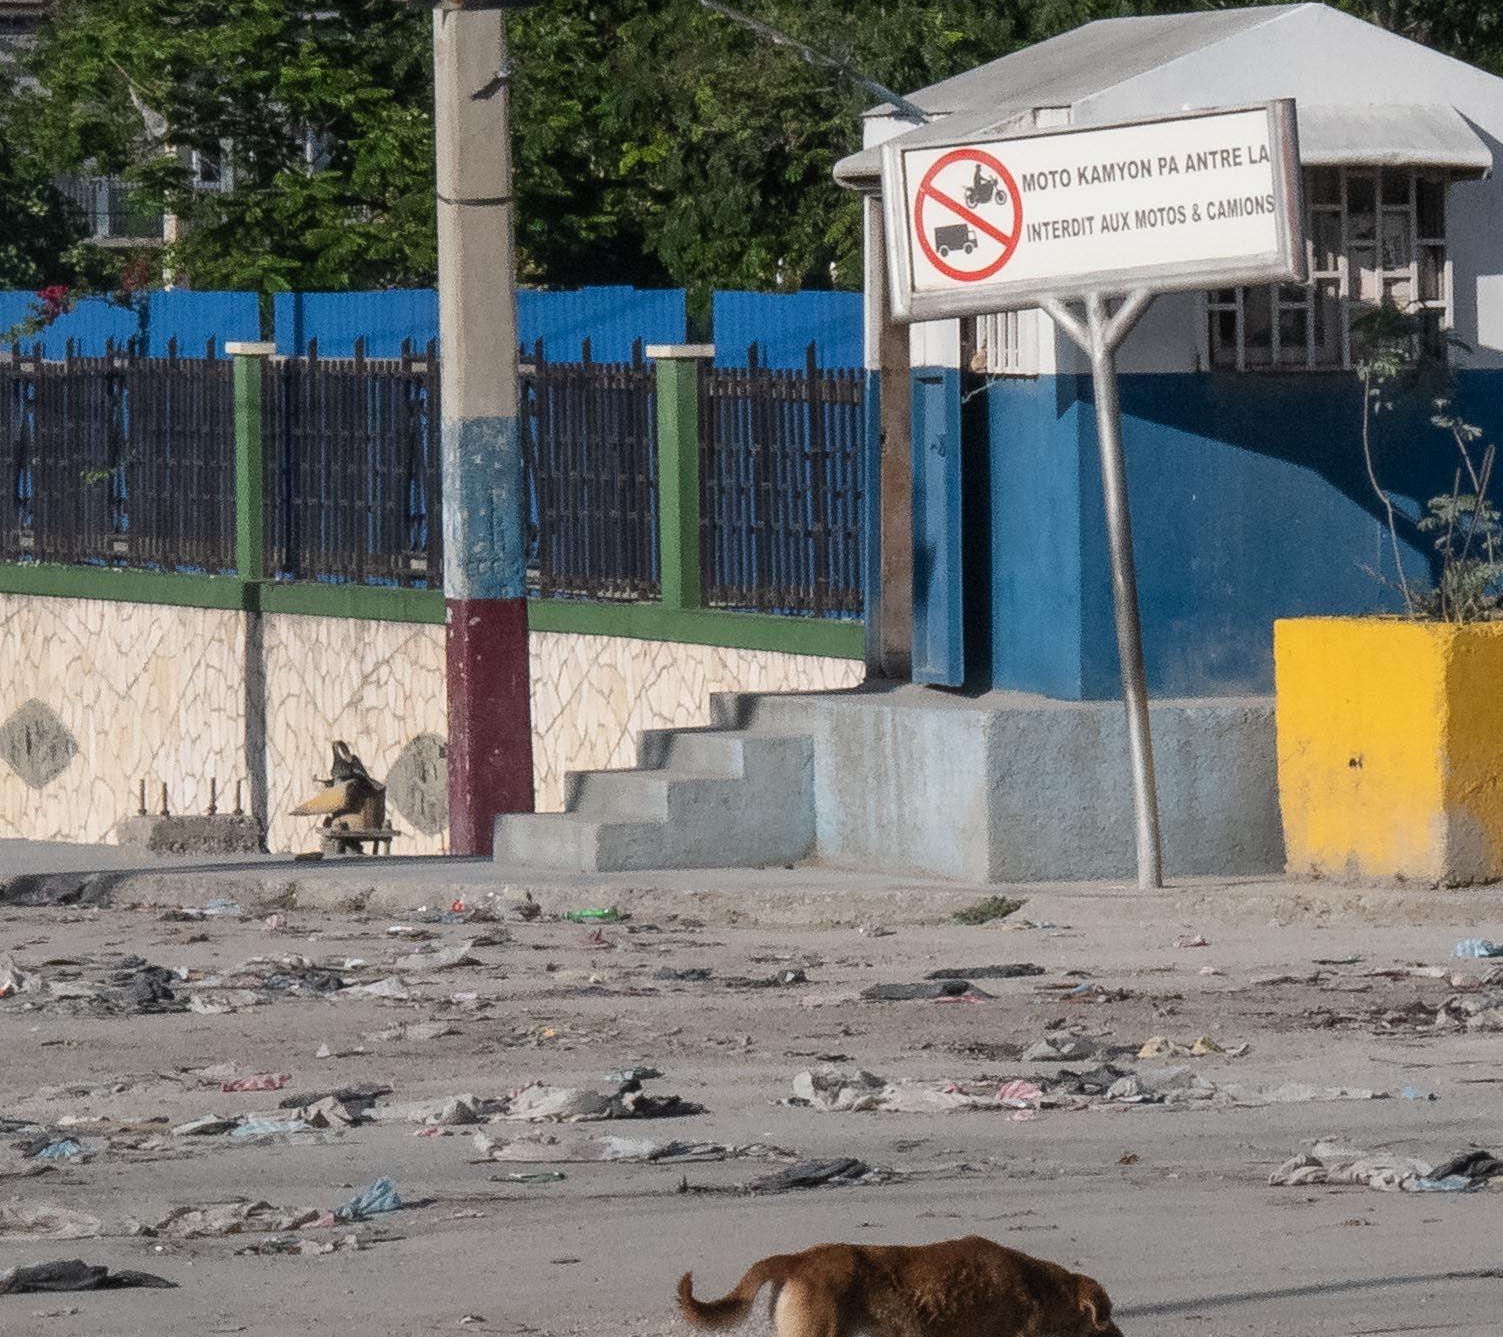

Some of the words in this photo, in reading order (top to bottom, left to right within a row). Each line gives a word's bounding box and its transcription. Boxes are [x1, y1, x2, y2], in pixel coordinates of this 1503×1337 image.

[1022, 170, 1072, 193] MOTO
[1077, 157, 1152, 186] KAMYON
[1158, 155, 1180, 176] PA
[1185, 146, 1243, 173] ANTRE
[1248, 143, 1271, 165] LA
[1027, 214, 1095, 243] INTERDIT
[1100, 211, 1131, 234] AUX
[1135, 203, 1187, 230] MOTOS
[1191, 205, 1202, 223] &
[1206, 194, 1276, 222] CAMIONS
